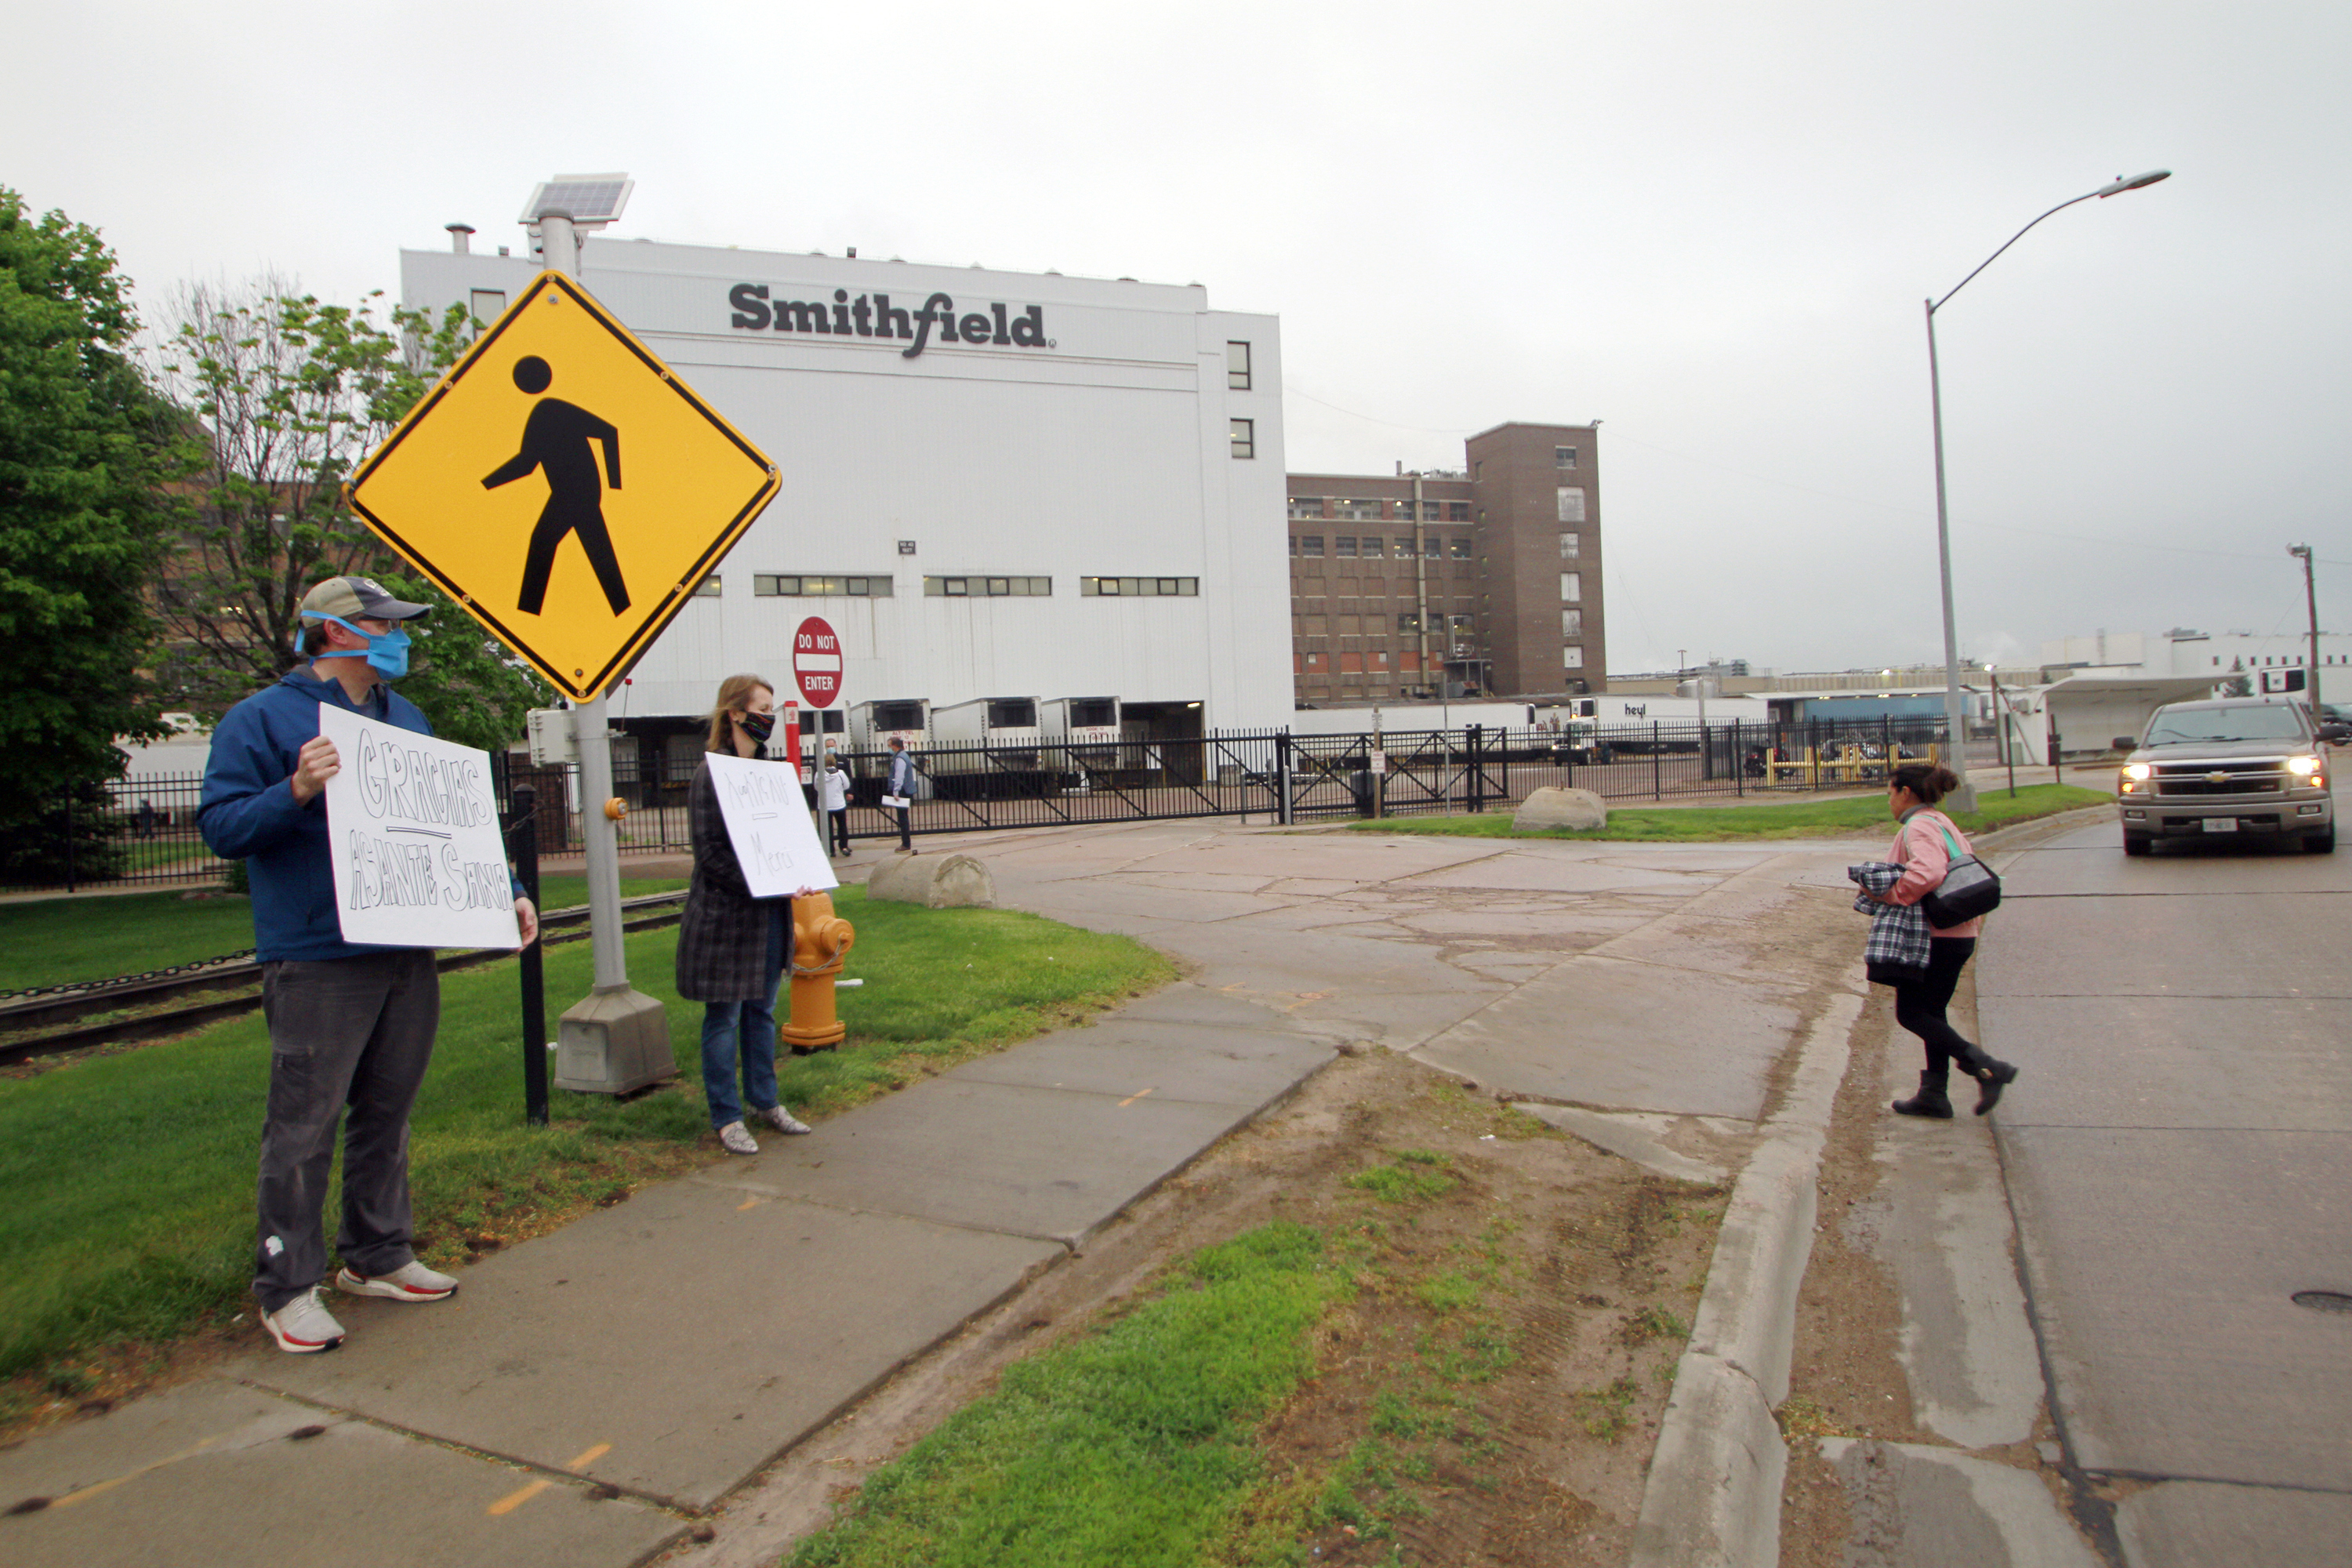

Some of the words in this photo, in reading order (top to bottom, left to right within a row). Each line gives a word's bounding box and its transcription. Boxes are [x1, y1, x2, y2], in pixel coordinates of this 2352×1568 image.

[728, 283, 1047, 358] Smithfield
[799, 633, 812, 649] DO
[817, 634, 835, 650] NOT
[804, 676, 834, 691] ENTER
[1624, 702, 1646, 719] heyl
[358, 728, 492, 828] GRACIAS
[350, 829, 438, 910] ASANTE
[441, 843, 514, 912] SANA
